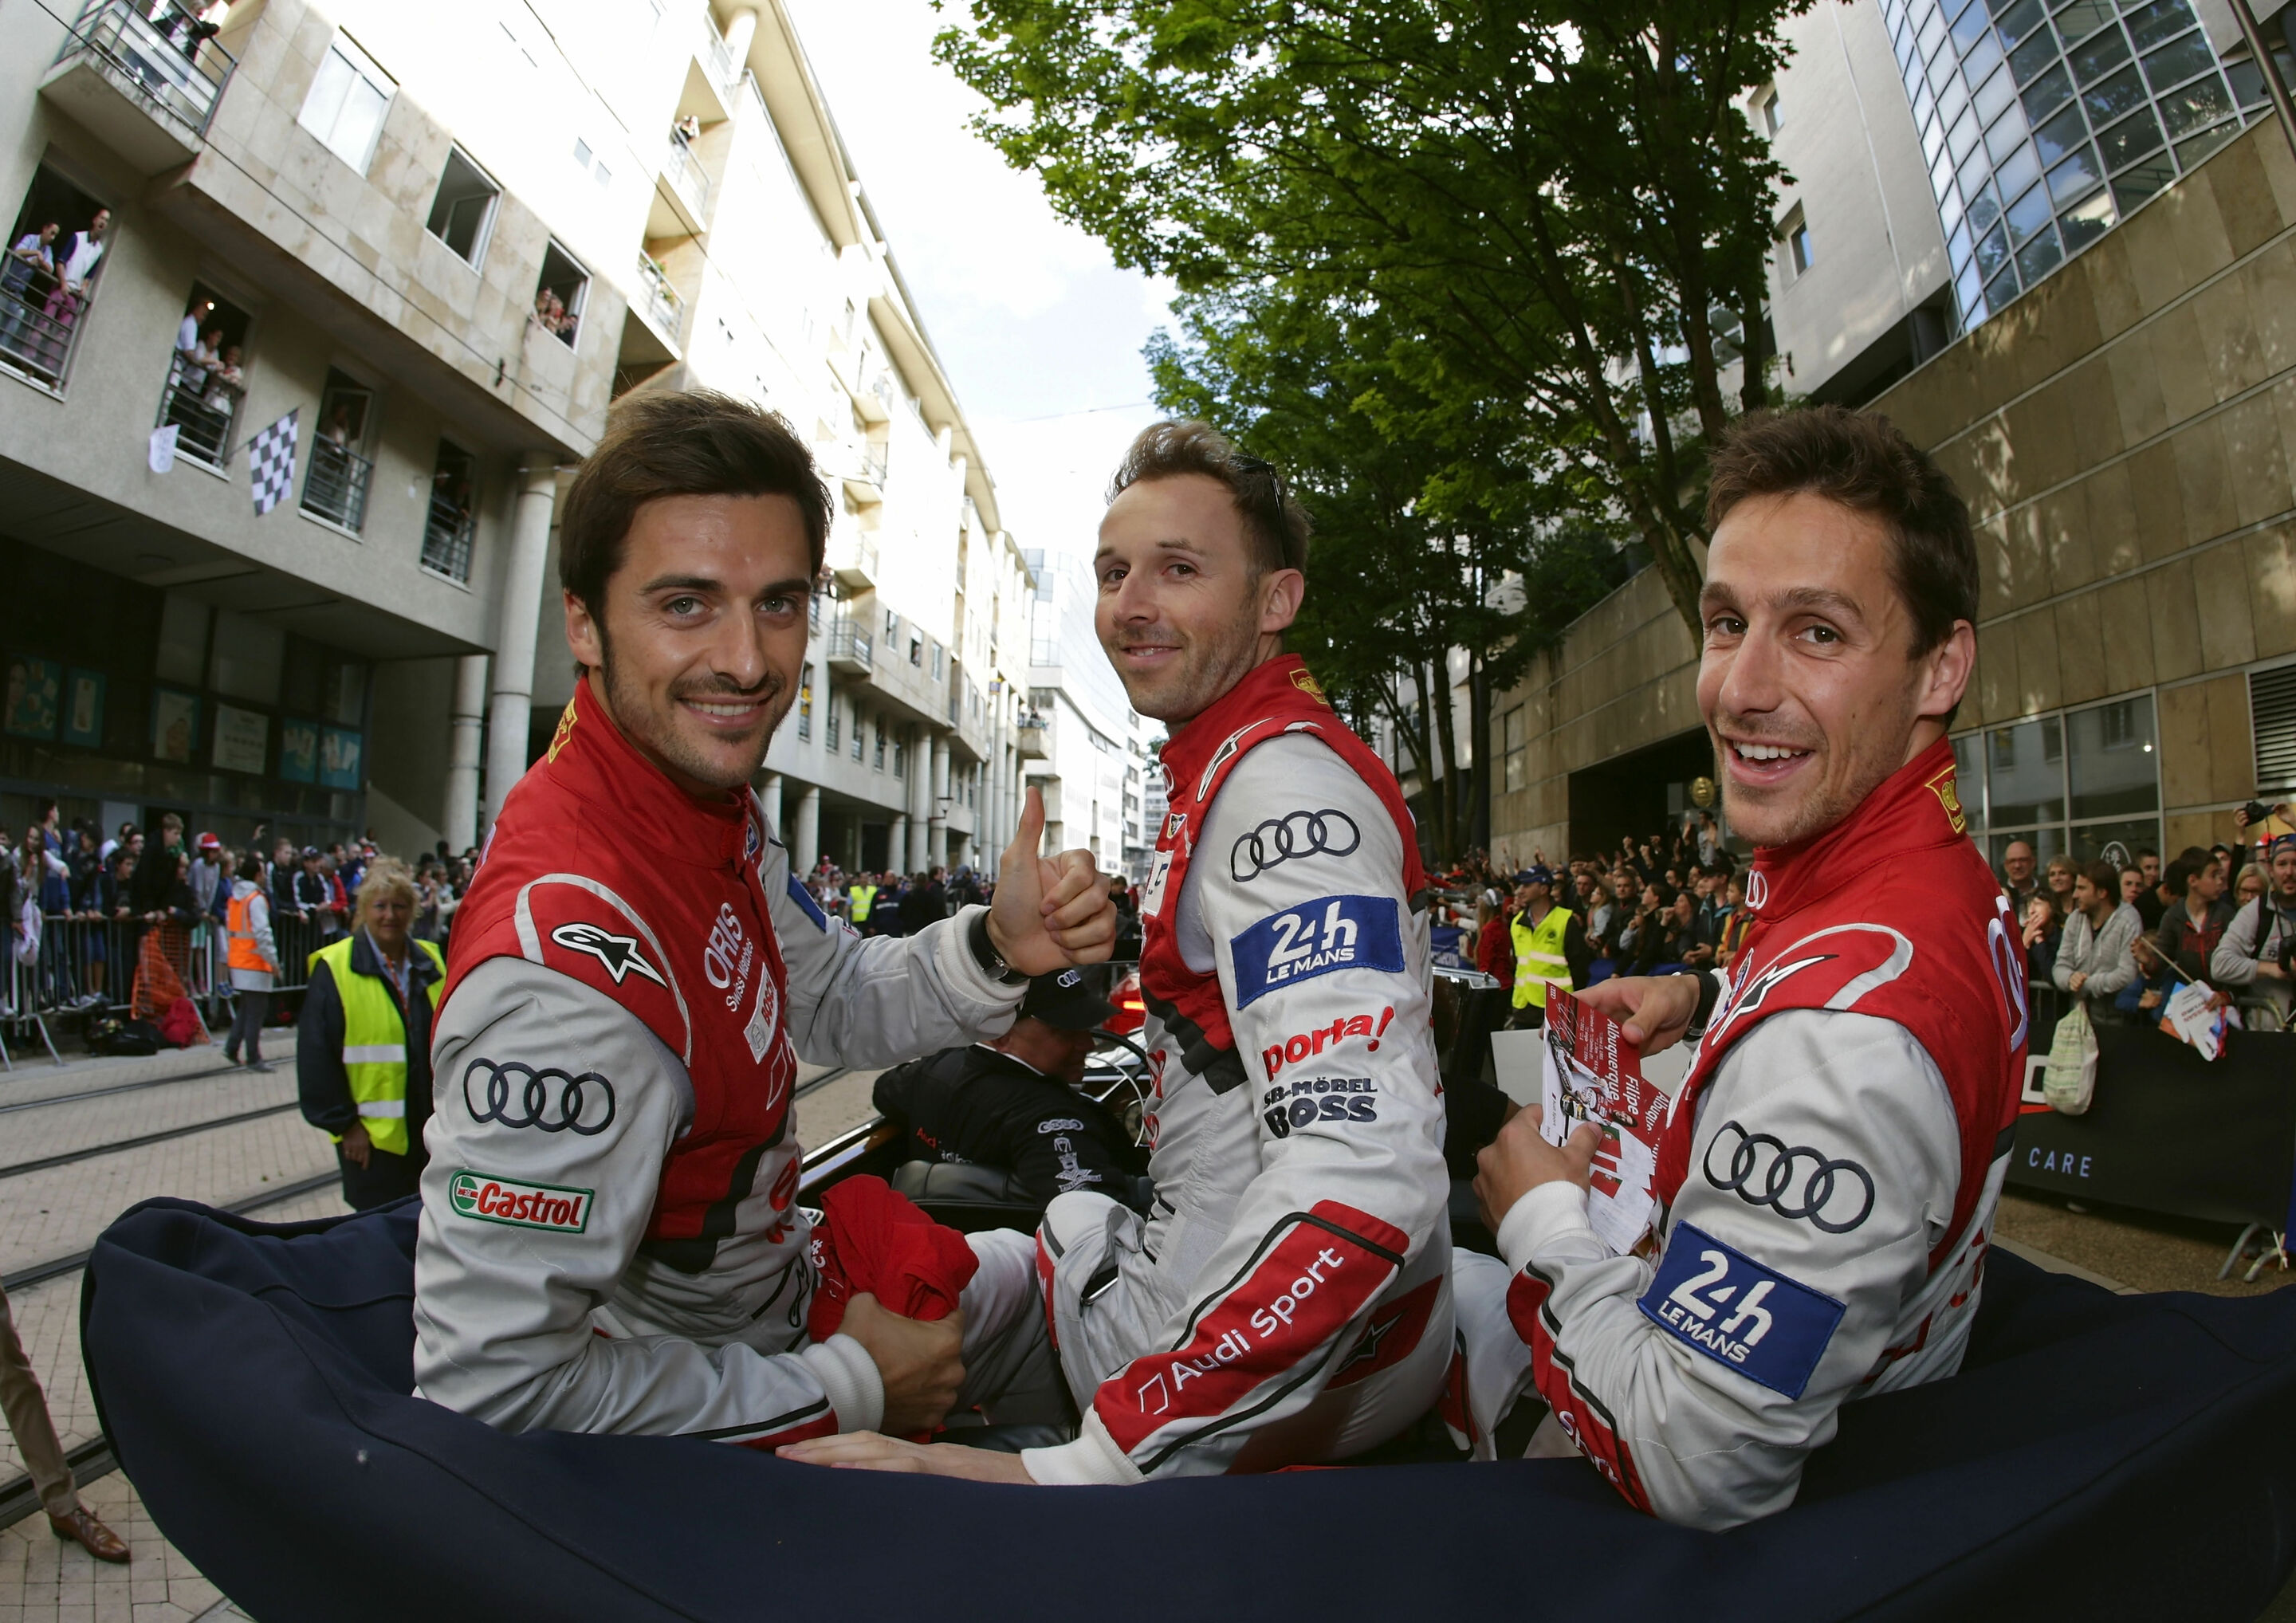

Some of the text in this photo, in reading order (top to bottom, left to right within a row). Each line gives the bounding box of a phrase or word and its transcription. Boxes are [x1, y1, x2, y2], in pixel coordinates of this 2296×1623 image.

[705, 902, 743, 988] ORIS
[1266, 948, 1354, 984] LE MANS
[1268, 901, 1358, 969] 24h
[726, 977, 746, 1012] Swiss
[1262, 1006, 1394, 1082] porta!
[1604, 1018, 1620, 1101] Albuquerque
[1264, 1094, 1378, 1139] BOSS
[1623, 1074, 1641, 1115] Filipe
[2029, 1147, 2092, 1177] CARE
[478, 1182, 583, 1226] Castrol
[1171, 1248, 1344, 1392] Audi Sport
[1669, 1250, 1775, 1346] 24h
[1658, 1300, 1750, 1363] LE MANS
